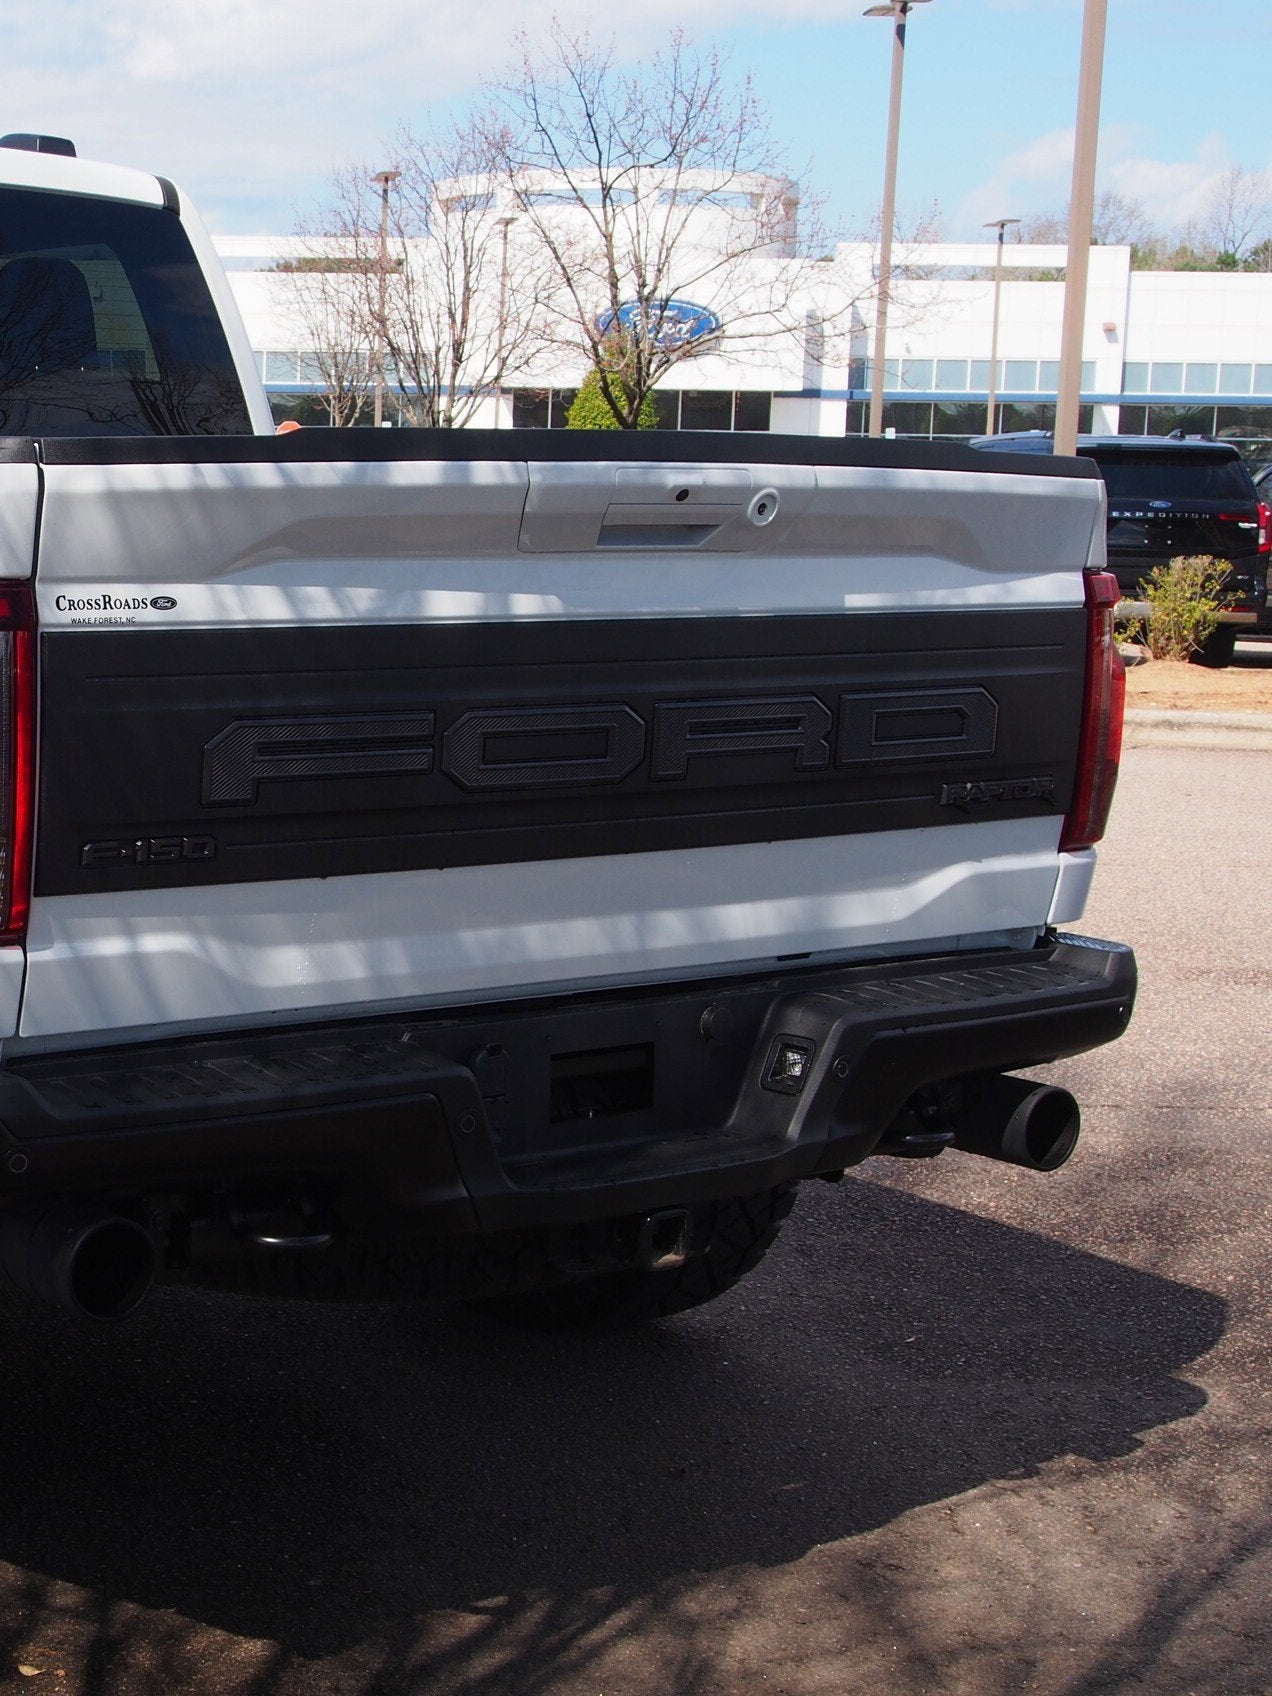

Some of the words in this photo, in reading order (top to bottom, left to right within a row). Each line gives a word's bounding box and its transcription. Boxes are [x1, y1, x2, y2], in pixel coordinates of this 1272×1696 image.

[1112, 511, 1210, 519] EXPEDITION
[71, 617, 92, 625] WAKE
[94, 616, 124, 625] FOREST,
[126, 616, 136, 624] NC
[200, 684, 998, 807] FORD
[939, 774, 1056, 805] RAPTOR
[80, 834, 217, 868] F-150
